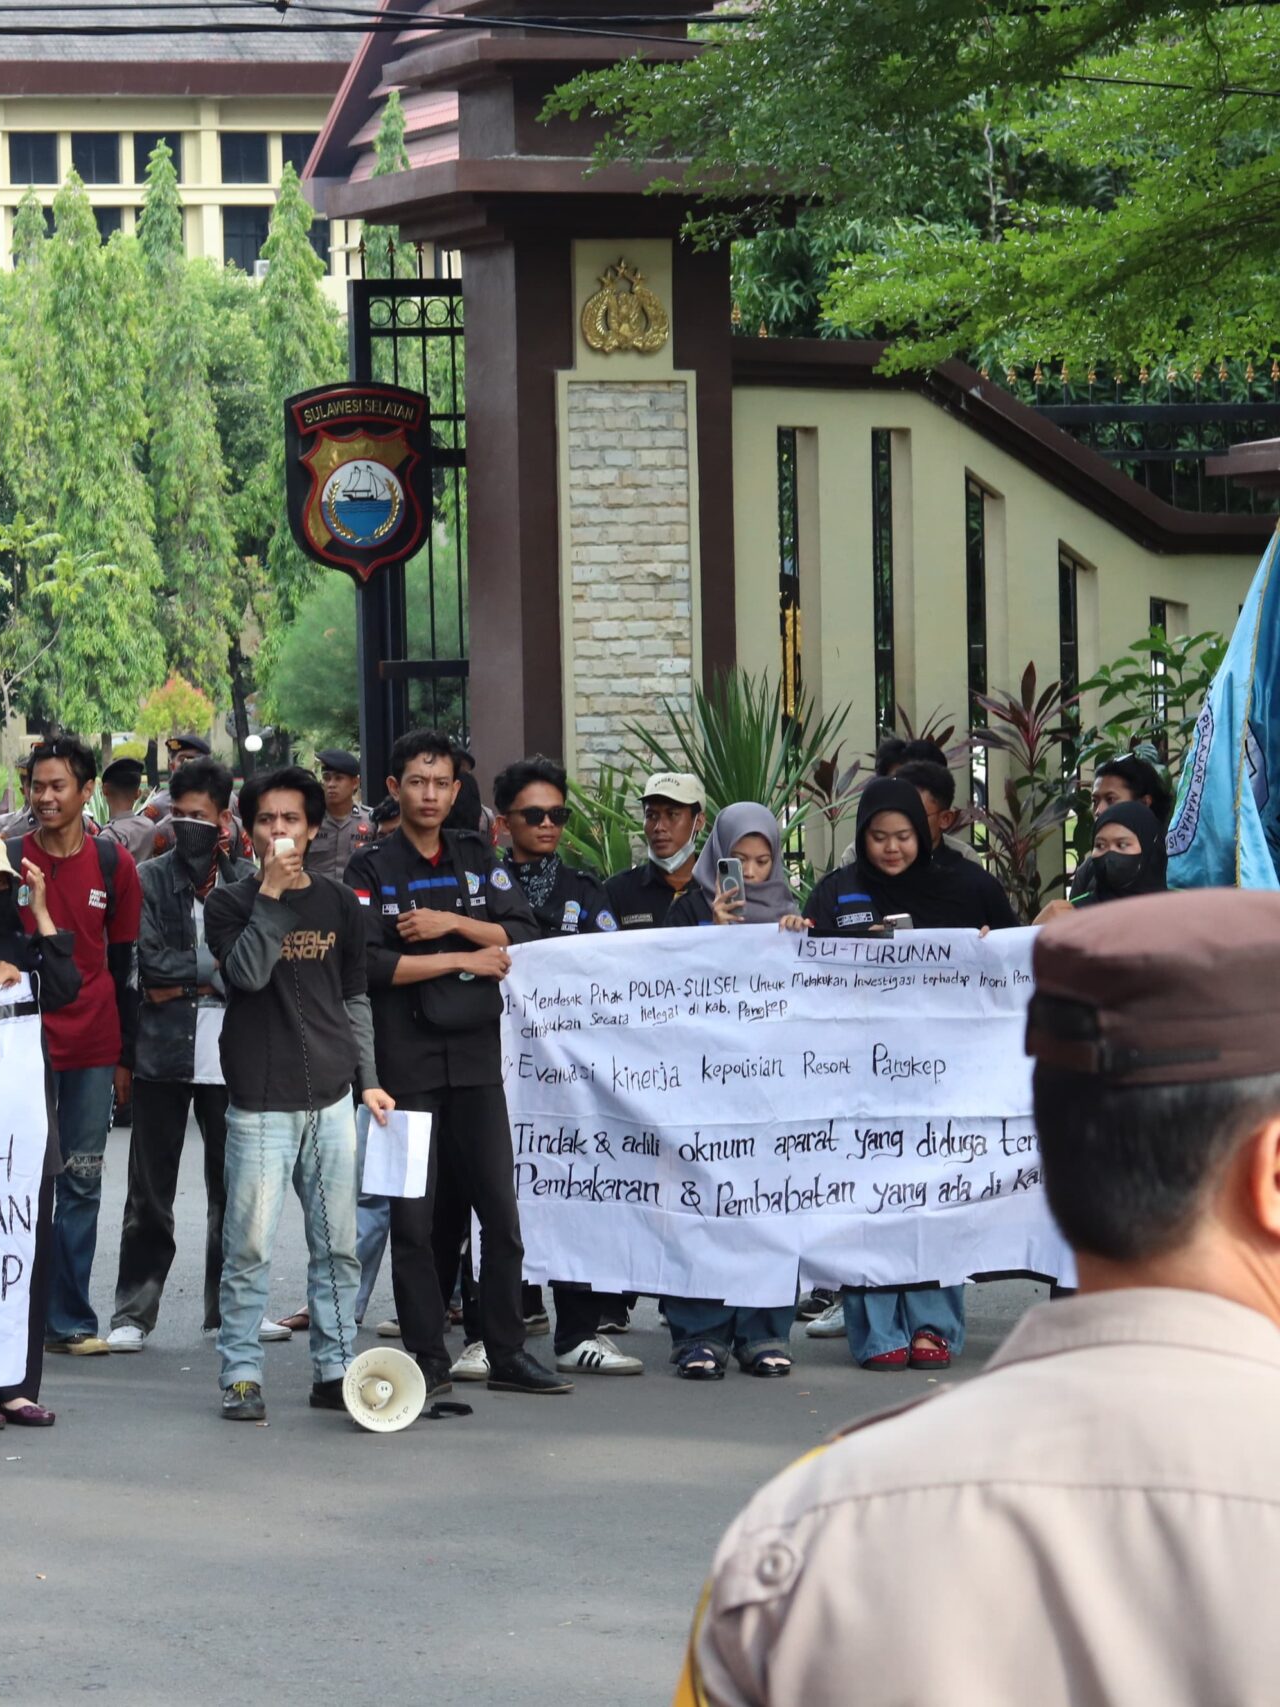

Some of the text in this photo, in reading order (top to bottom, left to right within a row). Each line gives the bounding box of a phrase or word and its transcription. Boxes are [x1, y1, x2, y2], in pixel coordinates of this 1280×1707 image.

[303, 399, 415, 424] SULAWESI SELATAN
[1192, 713, 1211, 785] PELAJAR
[590, 983, 623, 1006] Pihak
[749, 973, 786, 993] Untuk
[791, 972, 848, 988] Melakukan
[853, 971, 916, 993] Investigasi
[923, 970, 970, 988] terhadap
[1013, 969, 1035, 986] Pem
[688, 1002, 699, 1016] di
[518, 1053, 596, 1084] Evaluasi
[612, 1055, 682, 1092] kinerja
[701, 1053, 786, 1086] kepolisian
[803, 1050, 852, 1079] Resort
[513, 1122, 588, 1156] Tindak
[593, 1131, 617, 1161] &
[621, 1132, 661, 1158] adili
[678, 1131, 756, 1163] oknum
[773, 1119, 840, 1162] aparat
[845, 1127, 904, 1161] yang
[916, 1119, 988, 1167] diduga
[513, 1161, 664, 1206] Pembakaran
[679, 1180, 709, 1223] &
[715, 1171, 856, 1218] Pembabatan
[864, 1181, 928, 1215] yang
[938, 1173, 972, 1203] ada
[980, 1170, 1002, 1199] di
